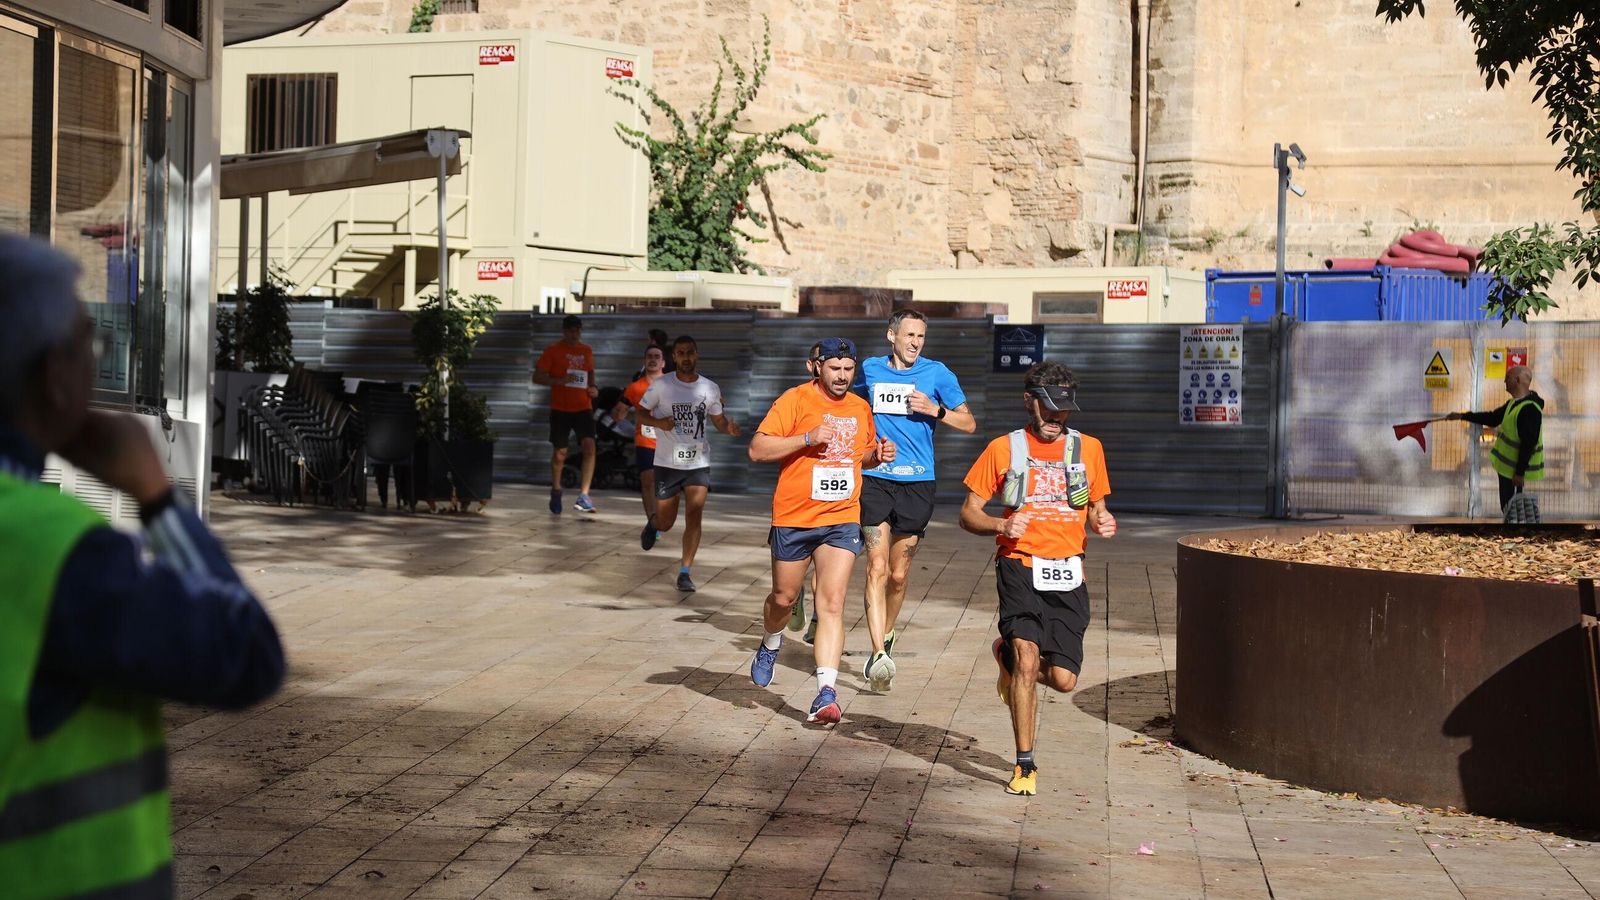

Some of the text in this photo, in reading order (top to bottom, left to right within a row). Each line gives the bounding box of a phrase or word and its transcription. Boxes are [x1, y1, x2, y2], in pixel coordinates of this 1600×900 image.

[480, 46, 515, 57] REMSA
[606, 58, 633, 71] REMSA
[478, 261, 513, 272] REMSA
[1108, 281, 1147, 292] REMSA
[1191, 327, 1233, 335] ¡ATENCIÓN!
[672, 404, 692, 412] ESTOY
[673, 412, 694, 421] LOCO
[678, 450, 697, 459] 837
[820, 479, 848, 491] 592
[1041, 567, 1074, 581] 583
